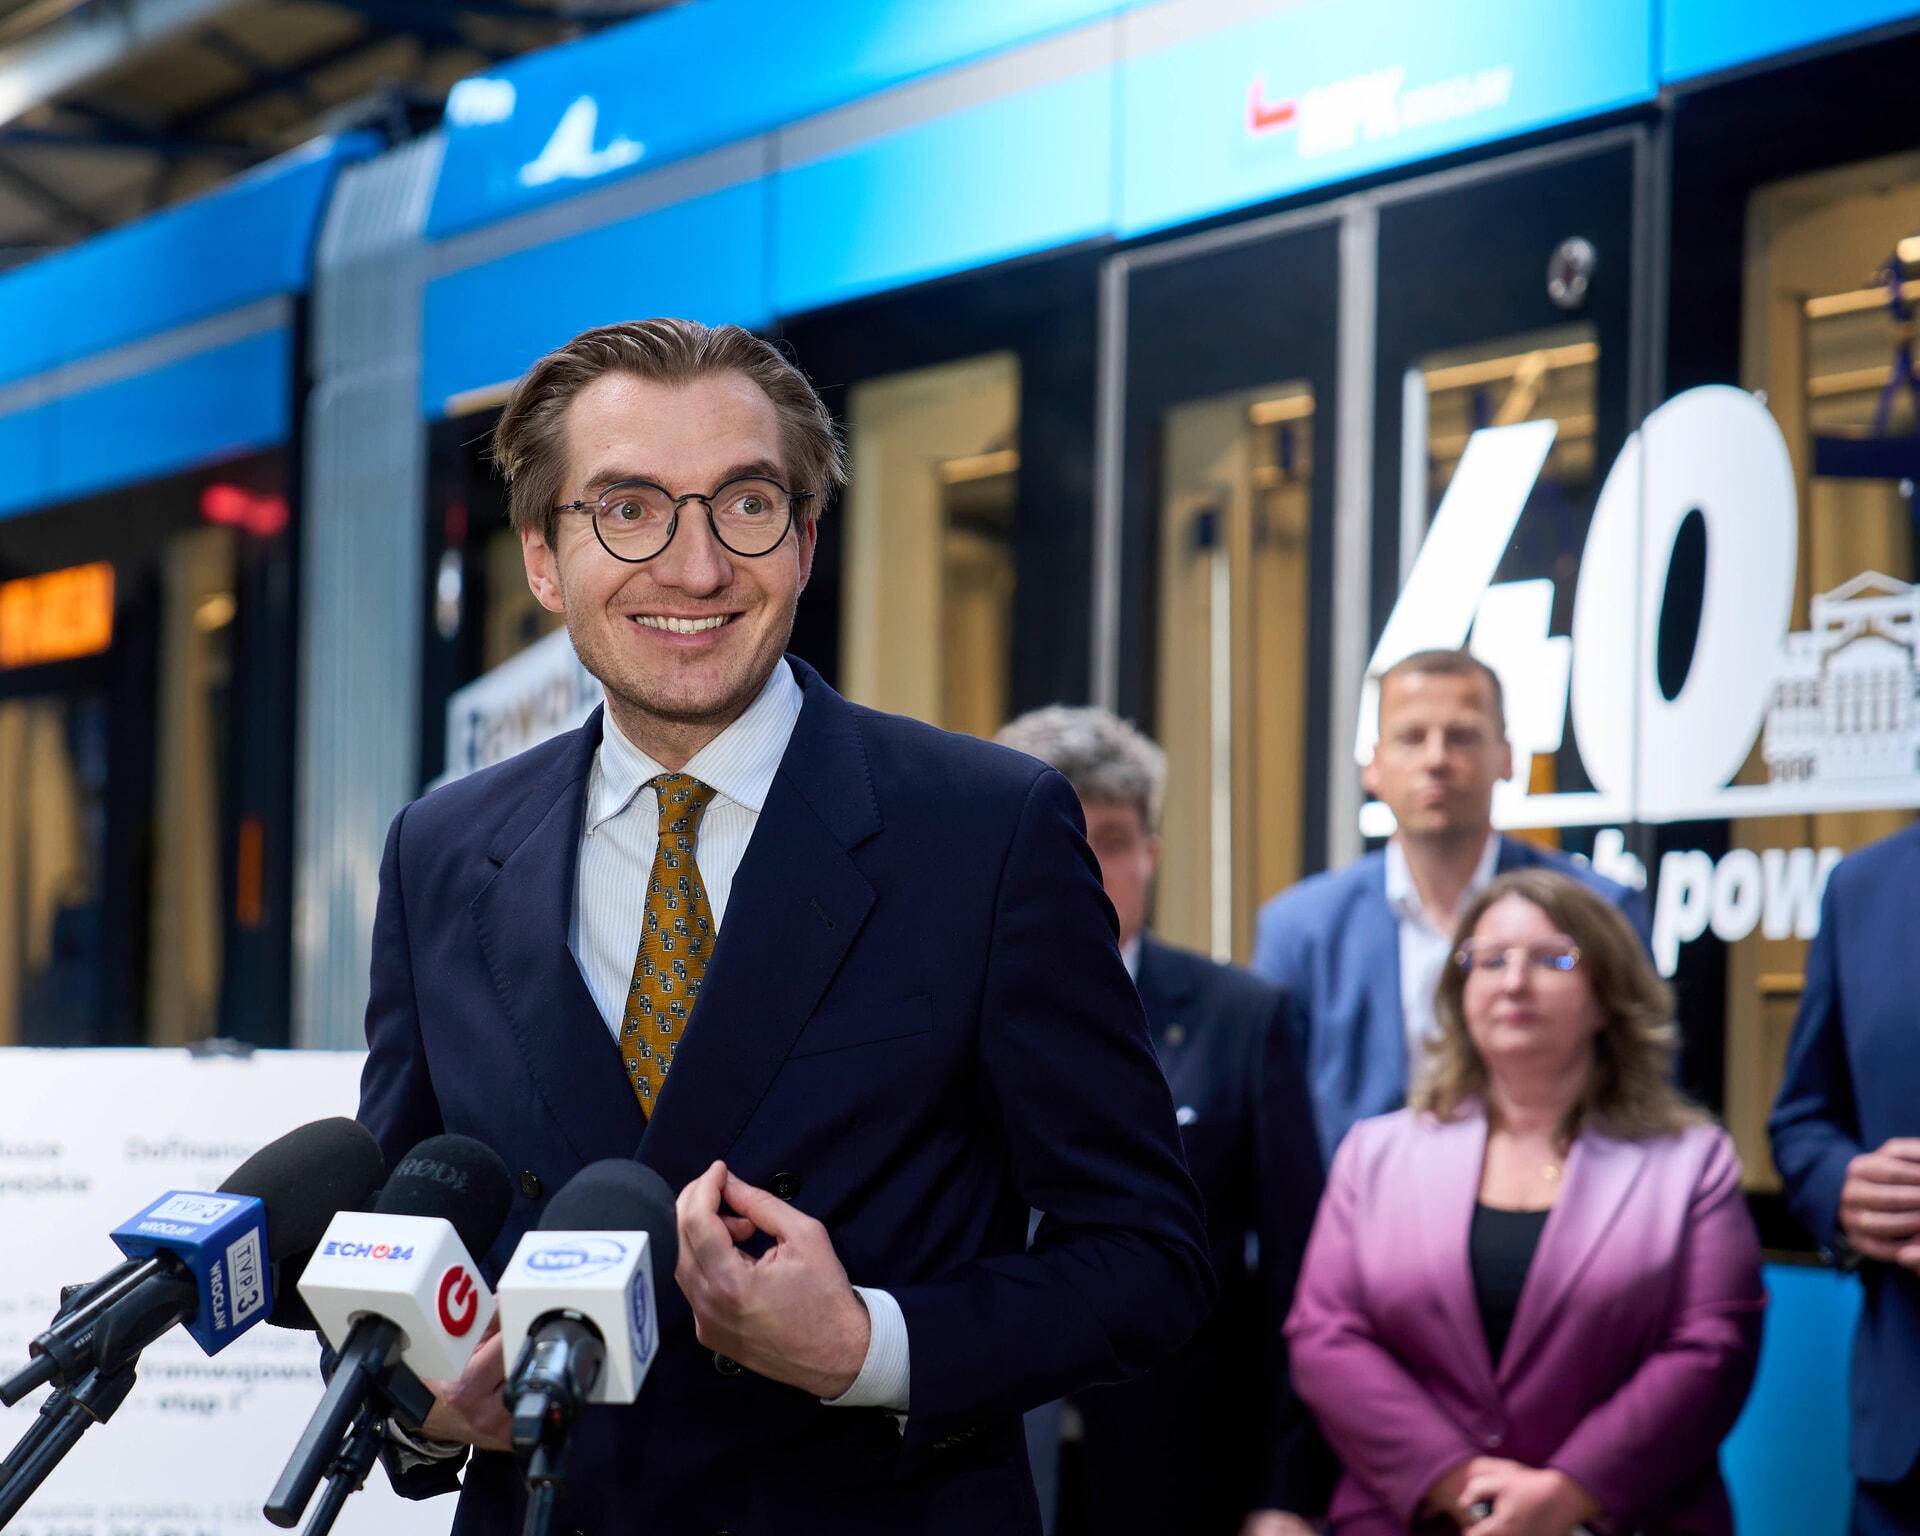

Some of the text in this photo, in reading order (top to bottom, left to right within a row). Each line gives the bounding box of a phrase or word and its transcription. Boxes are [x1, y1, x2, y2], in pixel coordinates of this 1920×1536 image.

[1355, 384, 1798, 830] 40
[323, 1240, 415, 1260] ECHO24
[210, 1260, 227, 1331] WROCŁAW
